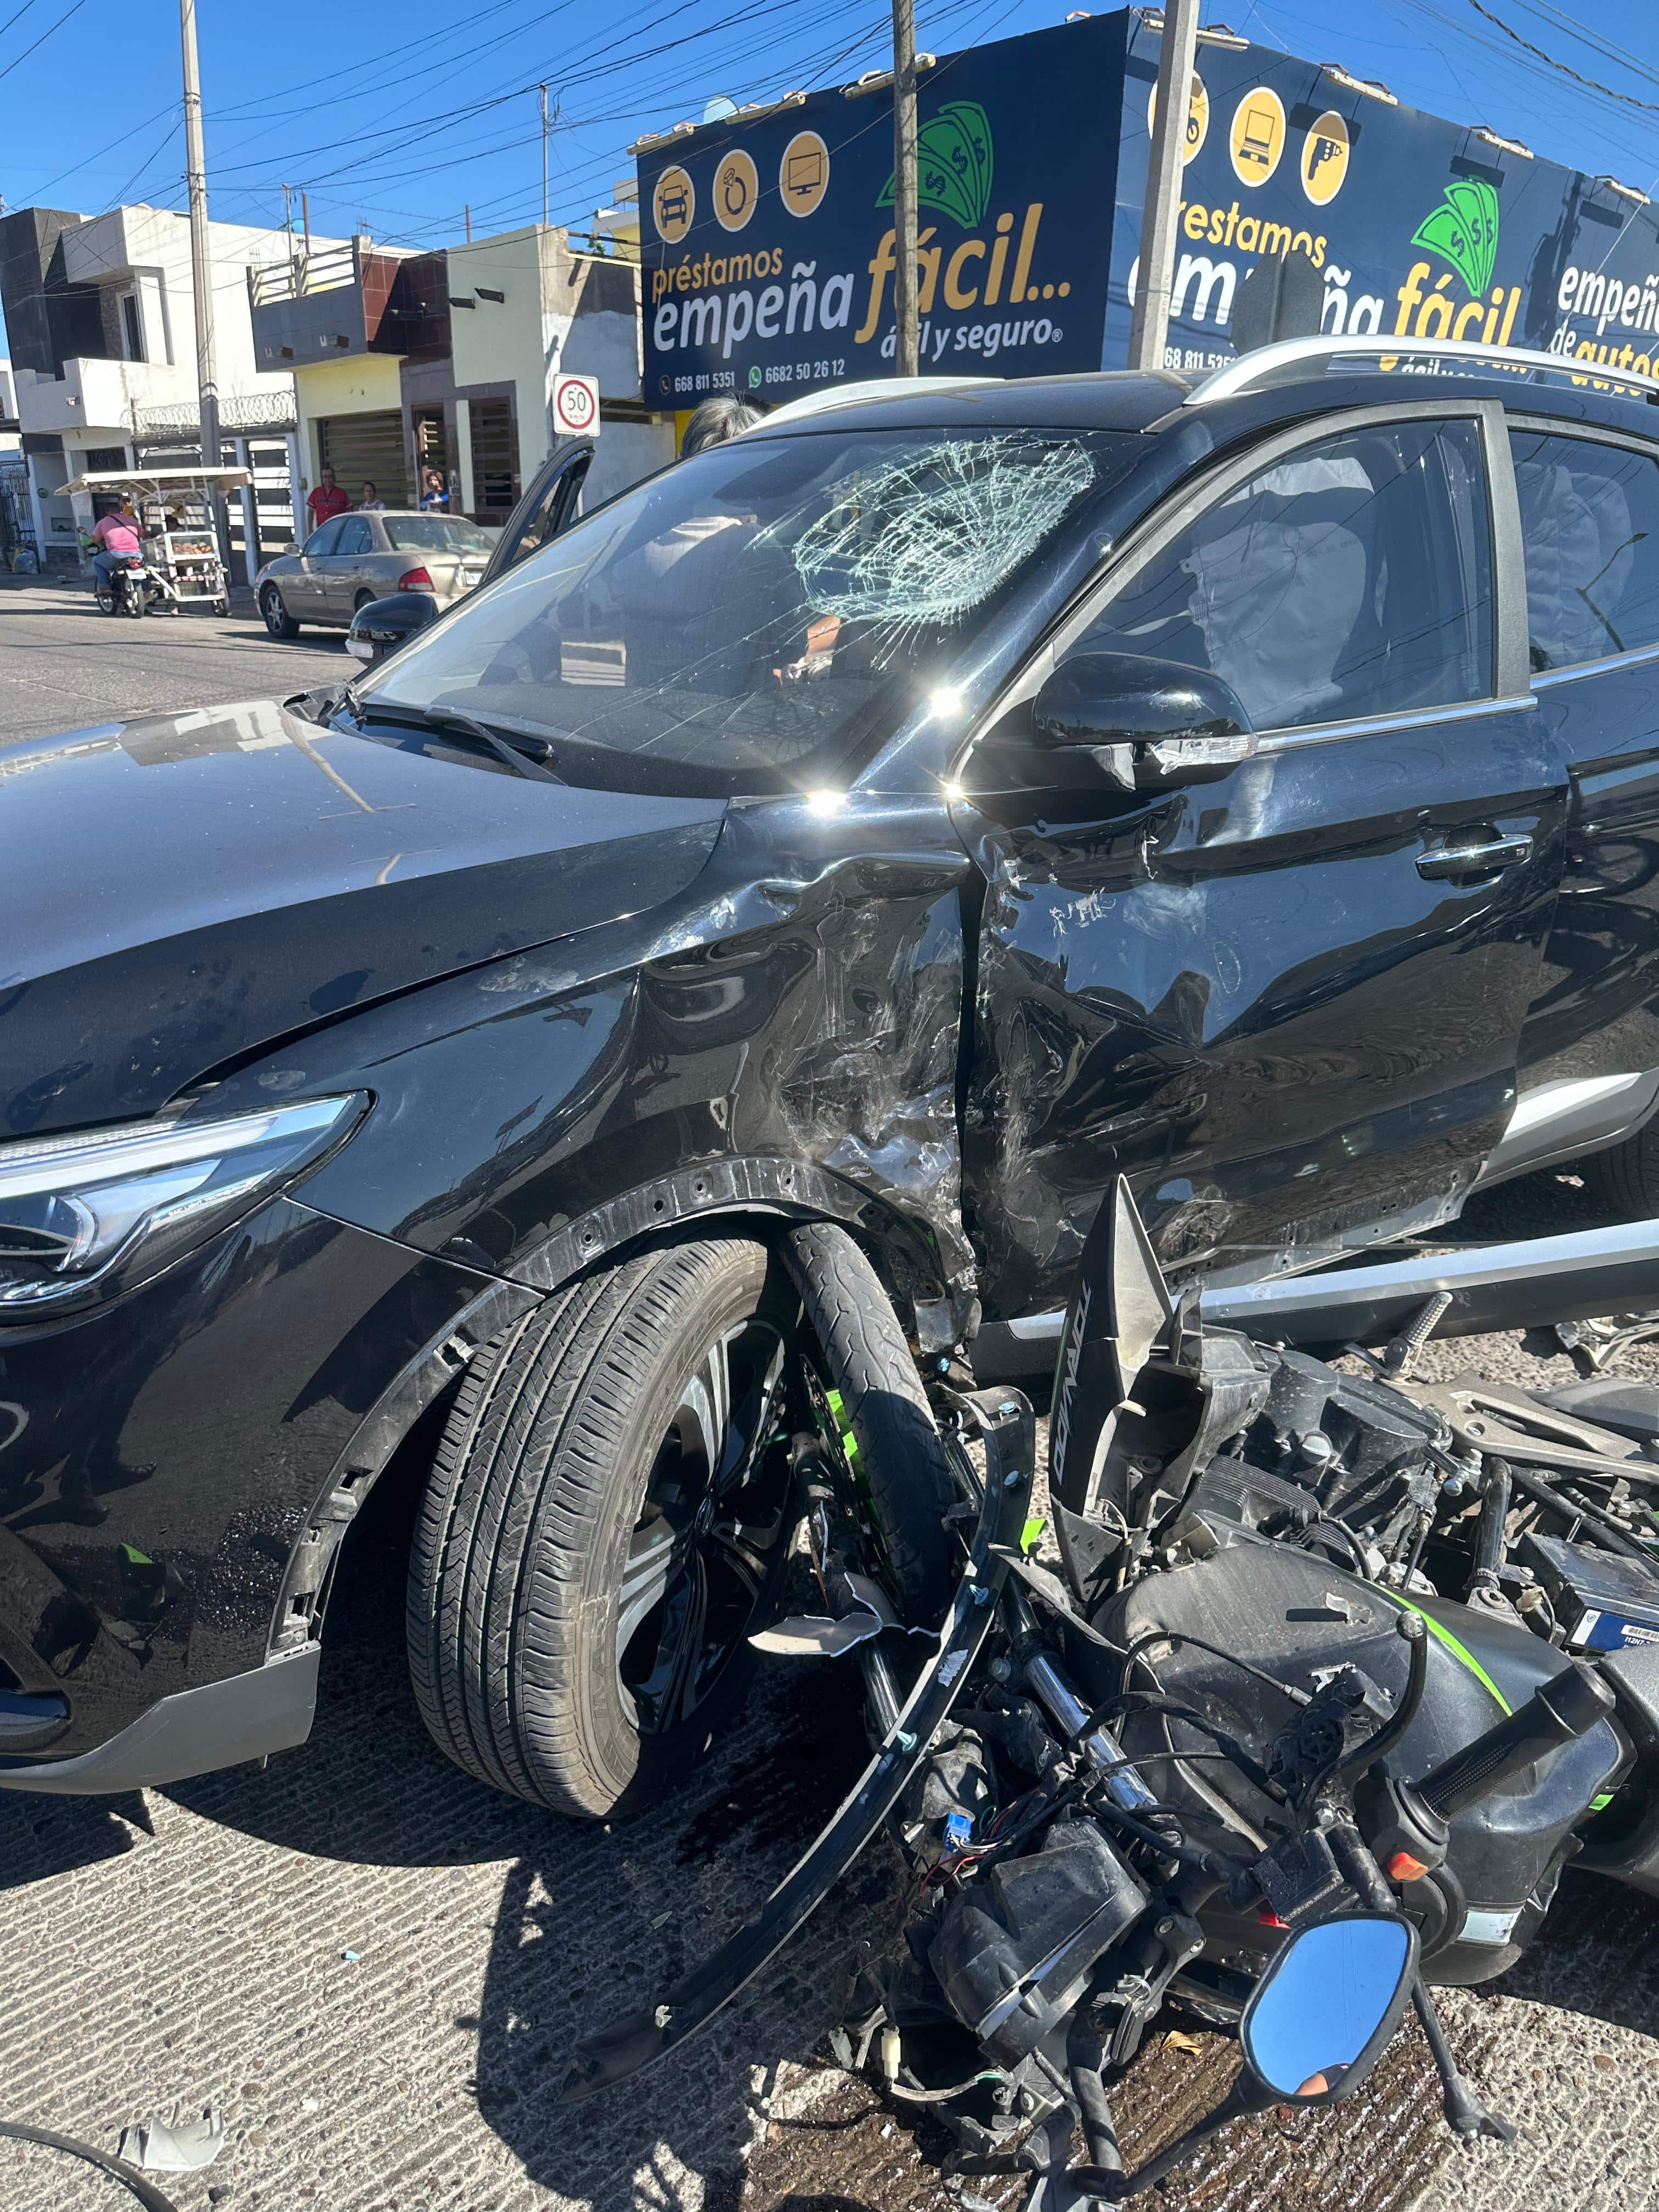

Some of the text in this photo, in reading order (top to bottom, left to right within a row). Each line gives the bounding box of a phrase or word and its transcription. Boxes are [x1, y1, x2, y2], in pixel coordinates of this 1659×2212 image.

[1178, 201, 1328, 268] estamos
[652, 247, 783, 303] préstamos
[653, 260, 855, 359] empeña
[1558, 266, 1659, 336] empeñ
[932, 328, 951, 363] y
[1550, 319, 1577, 357] de
[765, 358, 845, 383] 6682 50 26 12
[1164, 346, 1236, 369] 68 811 535
[674, 371, 736, 393] 668 811 5351
[568, 391, 586, 411] 50
